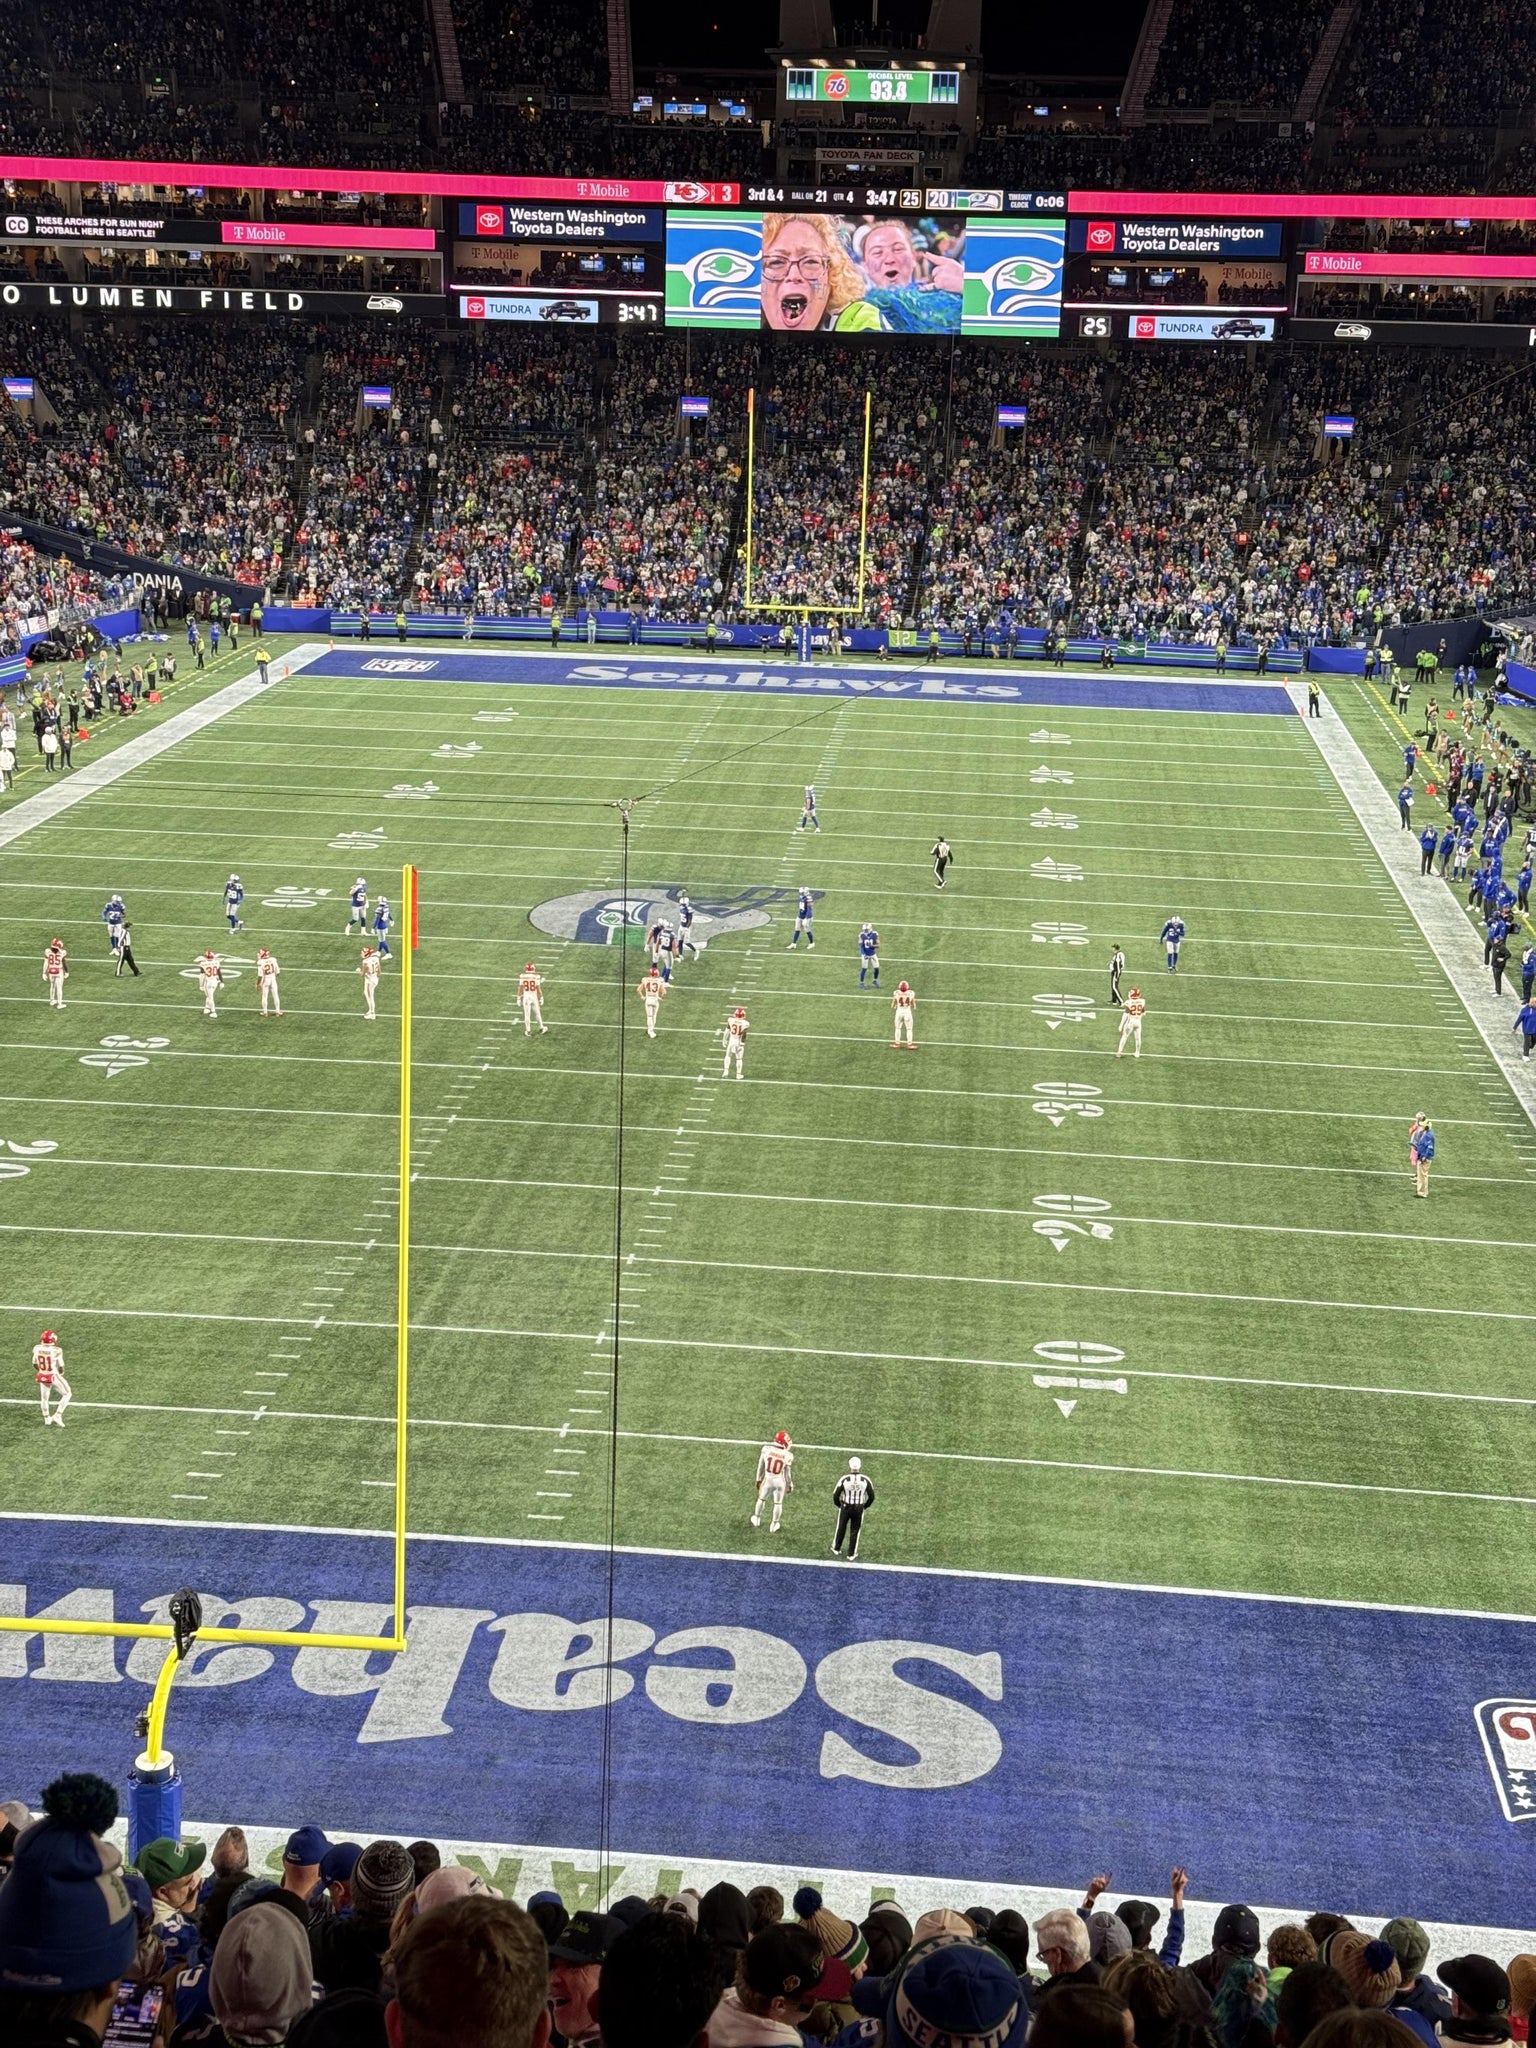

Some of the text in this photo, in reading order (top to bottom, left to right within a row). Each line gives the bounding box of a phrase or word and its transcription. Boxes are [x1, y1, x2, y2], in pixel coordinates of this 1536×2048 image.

[867, 72, 914, 81] DECIBEL LEVEL
[828, 78, 846, 94] 76
[821, 150, 914, 161] TOYOTA FAN DECK
[721, 185, 732, 202] 3
[748, 188, 784, 201] 3rd & 4
[815, 190, 828, 203] 21
[833, 191, 854, 203] QTR 4
[866, 189, 898, 206] 3:47
[902, 191, 919, 206] 25
[929, 191, 949, 207] 20
[1035, 196, 1065, 208] 0:06
[36, 216, 165, 229] THESE ARCHES FOR SUN NIGHT
[510, 207, 646, 226] Western Washington
[36, 226, 156, 238] FOOTBALL HERE IN SEATTLE!
[510, 221, 605, 237] Toyota Dealers
[1122, 224, 1264, 240] Western Washington
[1122, 237, 1220, 252] Toyota Dealers
[3, 285, 304, 311] O LUMEN FIELD
[489, 303, 532, 315] TUNDRA
[618, 303, 657, 322] 3:47
[1084, 318, 1107, 336] 25
[1159, 322, 1204, 334] TUNDRA
[133, 572, 183, 591] DANIA
[895, 631, 910, 645] 12
[566, 665, 1021, 697] Seahawks
[48, 954, 61, 966] 85
[206, 966, 218, 978] 30
[264, 963, 275, 975] 21
[645, 982, 658, 994] 43
[898, 997, 910, 1007] 44
[731, 1023, 743, 1036] 31
[78, 1034, 171, 1068] 30
[1032, 1082, 1105, 1117] 30
[1032, 1194, 1114, 1240] 20
[38, 1355, 52, 1371] 81
[1032, 1340, 1128, 1394] 10
[766, 1457, 784, 1475] 10
